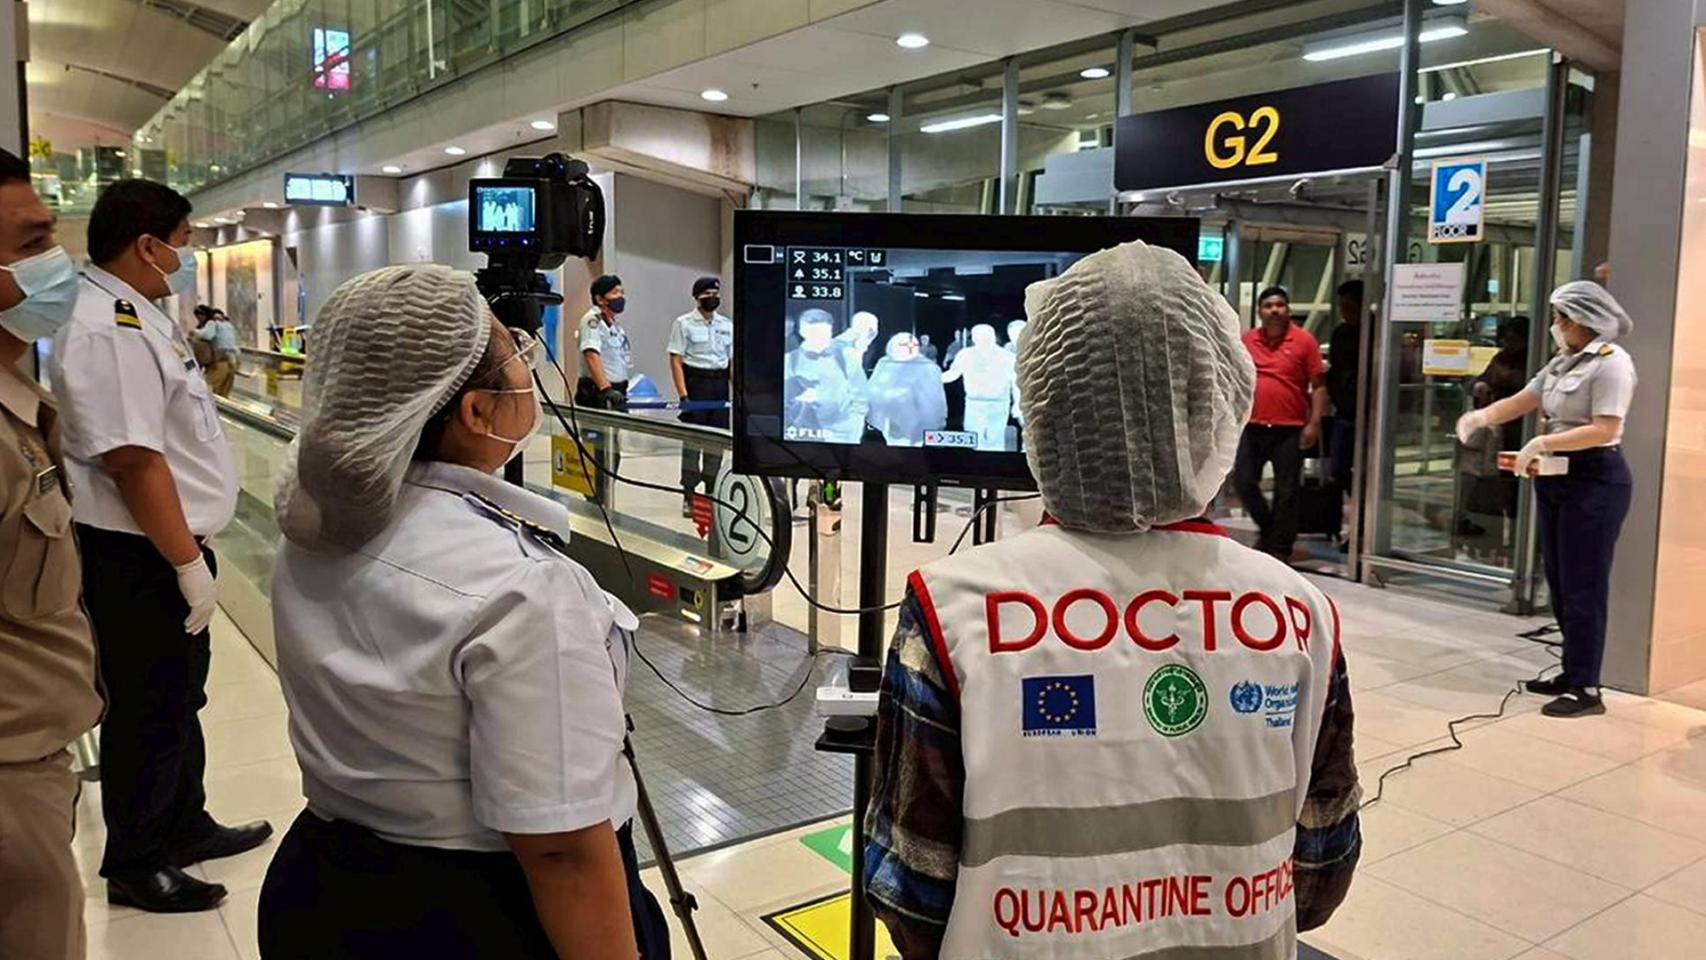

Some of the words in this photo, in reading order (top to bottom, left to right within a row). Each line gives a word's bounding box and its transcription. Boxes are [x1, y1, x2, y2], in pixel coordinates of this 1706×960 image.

[1205, 106, 1279, 169] G2
[1446, 168, 1481, 223] 2
[812, 252, 841, 264] 34.1
[812, 268, 841, 280] 35.1
[812, 286, 842, 298] 33.8
[729, 481, 748, 544] 2
[985, 588, 1311, 654] DOCTOR
[994, 875, 1212, 937] QUARANTINE
